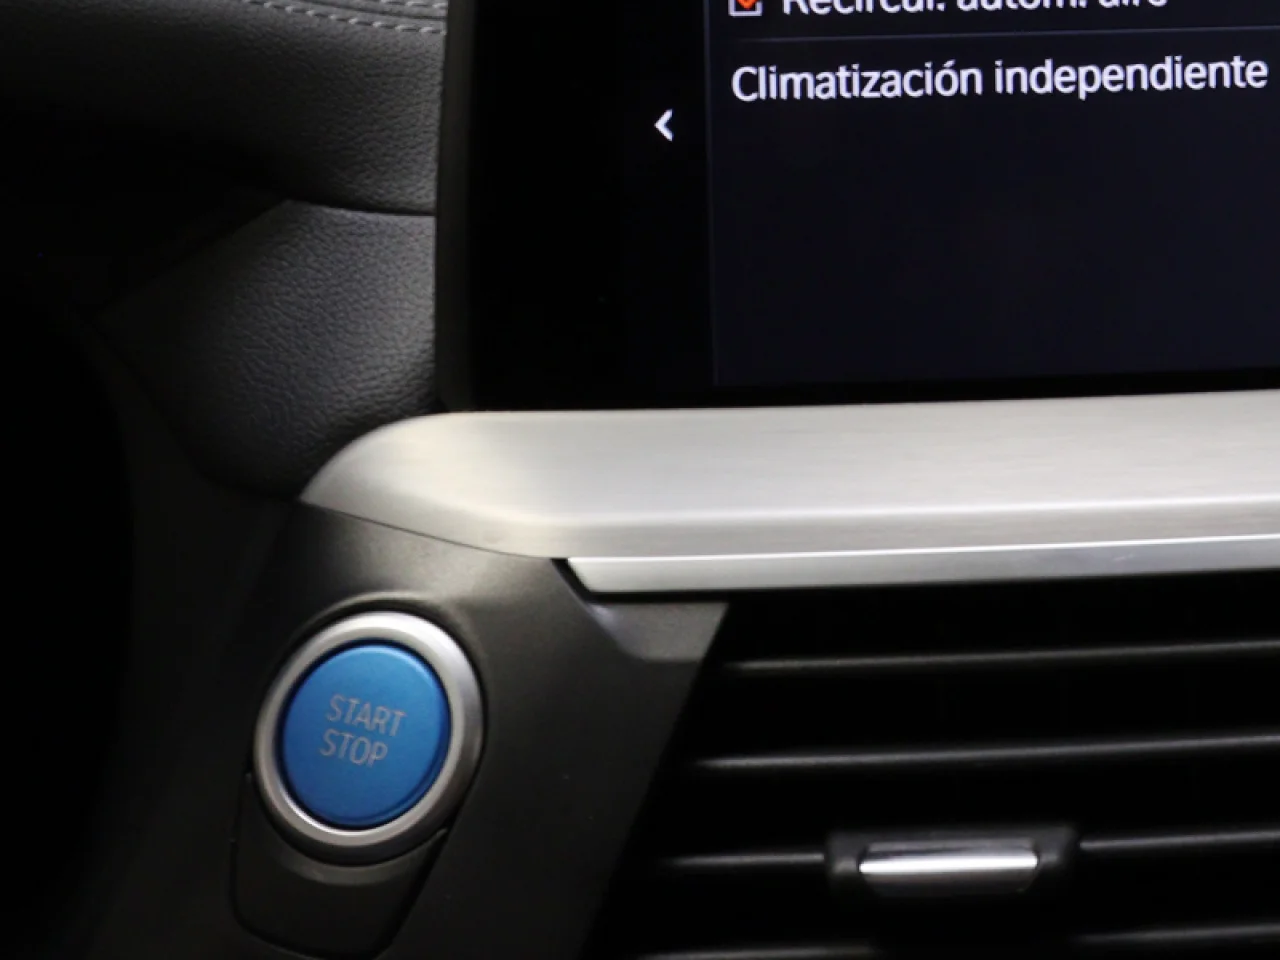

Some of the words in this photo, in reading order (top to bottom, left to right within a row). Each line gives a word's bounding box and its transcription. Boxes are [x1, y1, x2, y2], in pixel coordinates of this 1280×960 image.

[732, 59, 984, 102] Climatización
[995, 55, 1270, 101] independiente
[327, 694, 408, 737] START
[319, 729, 388, 767] STOP
